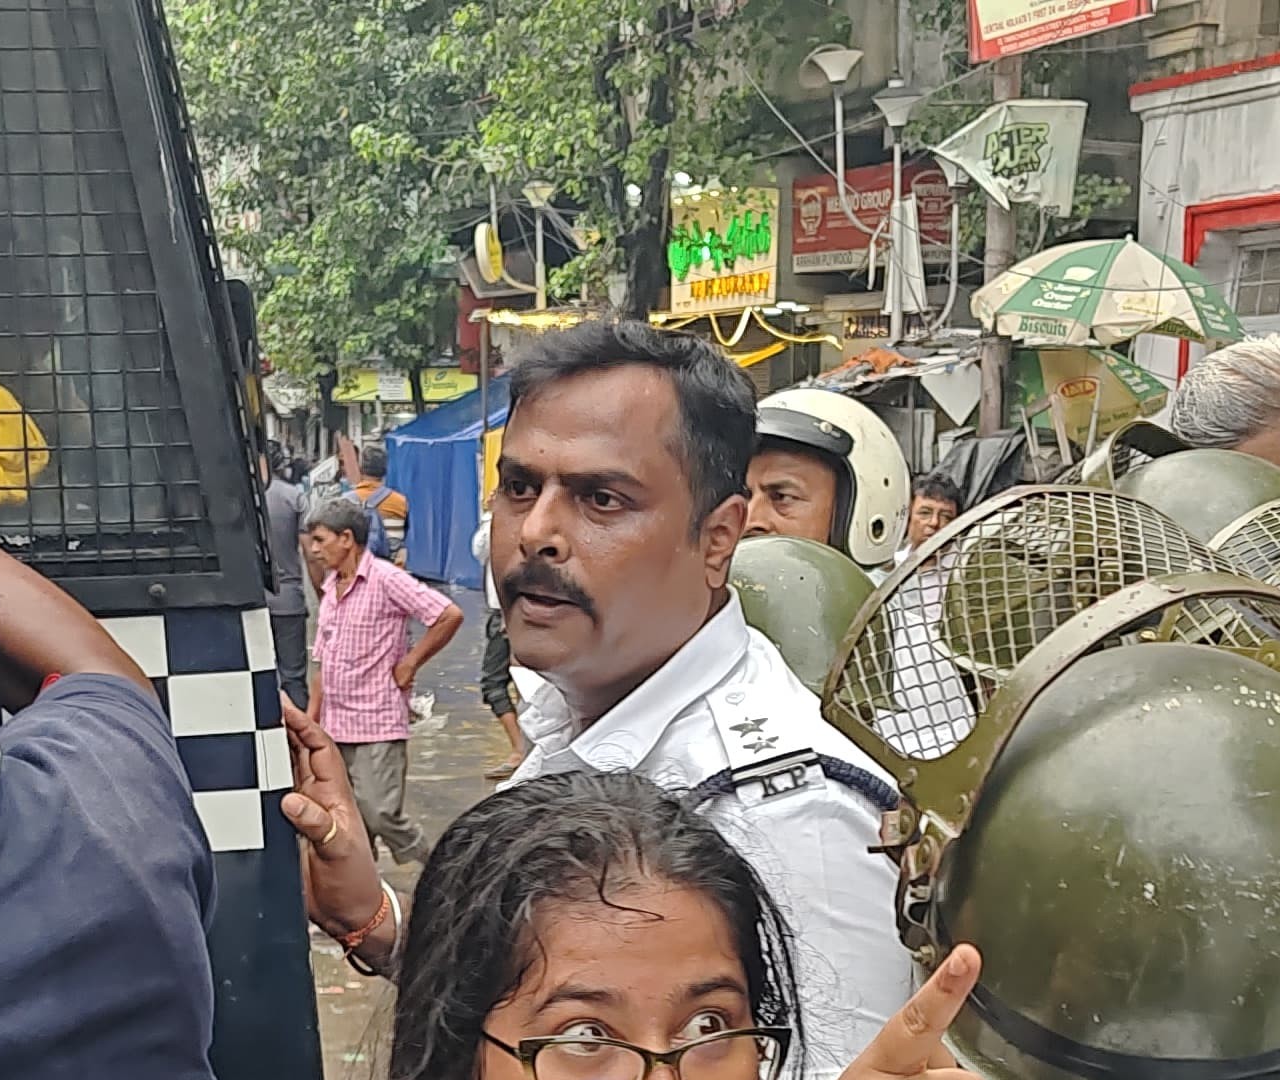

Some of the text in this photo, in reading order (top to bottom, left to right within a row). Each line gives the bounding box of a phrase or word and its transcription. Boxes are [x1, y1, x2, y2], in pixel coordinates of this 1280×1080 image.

[983, 122, 1051, 160] AFTER
[861, 188, 892, 210] GROUP
[1019, 316, 1068, 338] Biscuits
